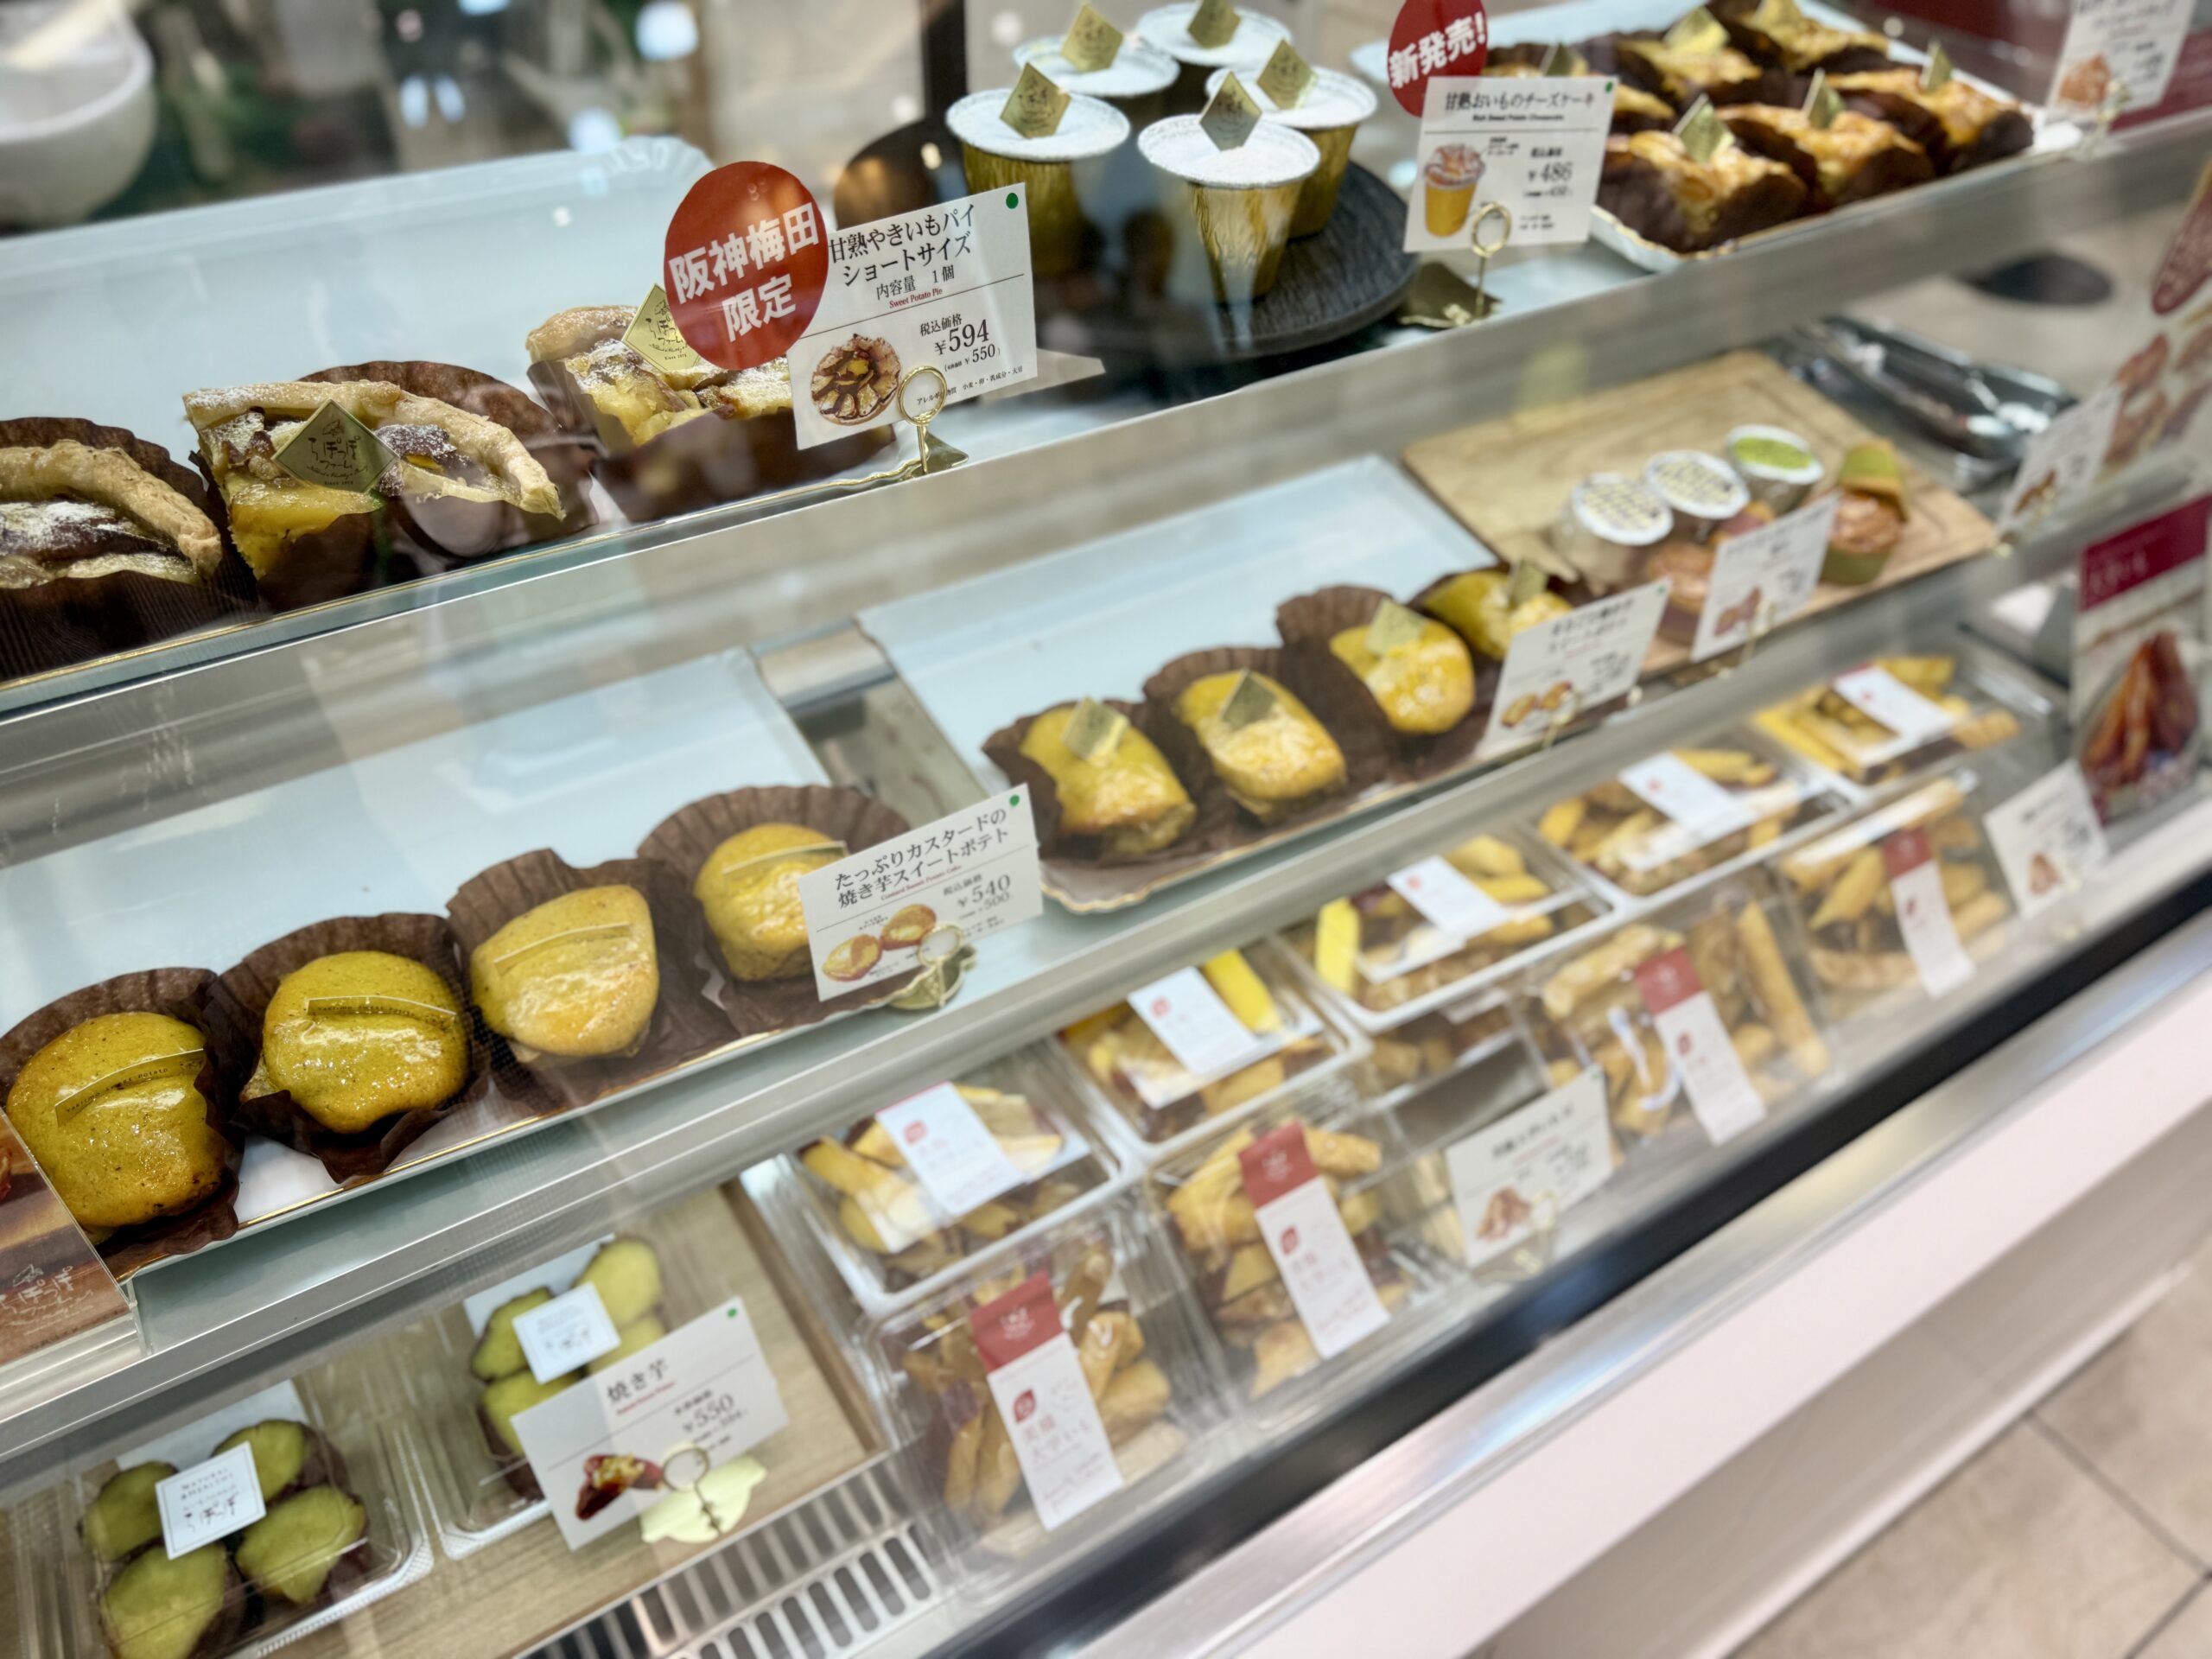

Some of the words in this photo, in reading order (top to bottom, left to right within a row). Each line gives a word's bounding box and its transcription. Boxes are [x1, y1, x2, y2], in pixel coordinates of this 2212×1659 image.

[1389, 11, 1488, 89] 新発売!
[669, 202, 820, 304] 阪神梅田
[829, 203, 976, 264] 甘熟やきいもパイ
[843, 232, 972, 288] ショートサイズ
[721, 274, 797, 343] 限定
[876, 276, 917, 300] 内容量
[931, 264, 956, 284] 1個
[889, 297, 909, 308] Sweet
[910, 291, 931, 302] Potato
[931, 288, 943, 296] Pie
[919, 313, 963, 337] 税込価格
[934, 319, 989, 355] ¥594
[835, 808, 1007, 890] たっぷりカスタードの
[837, 828, 1008, 908] 焼き芋スイートポテト
